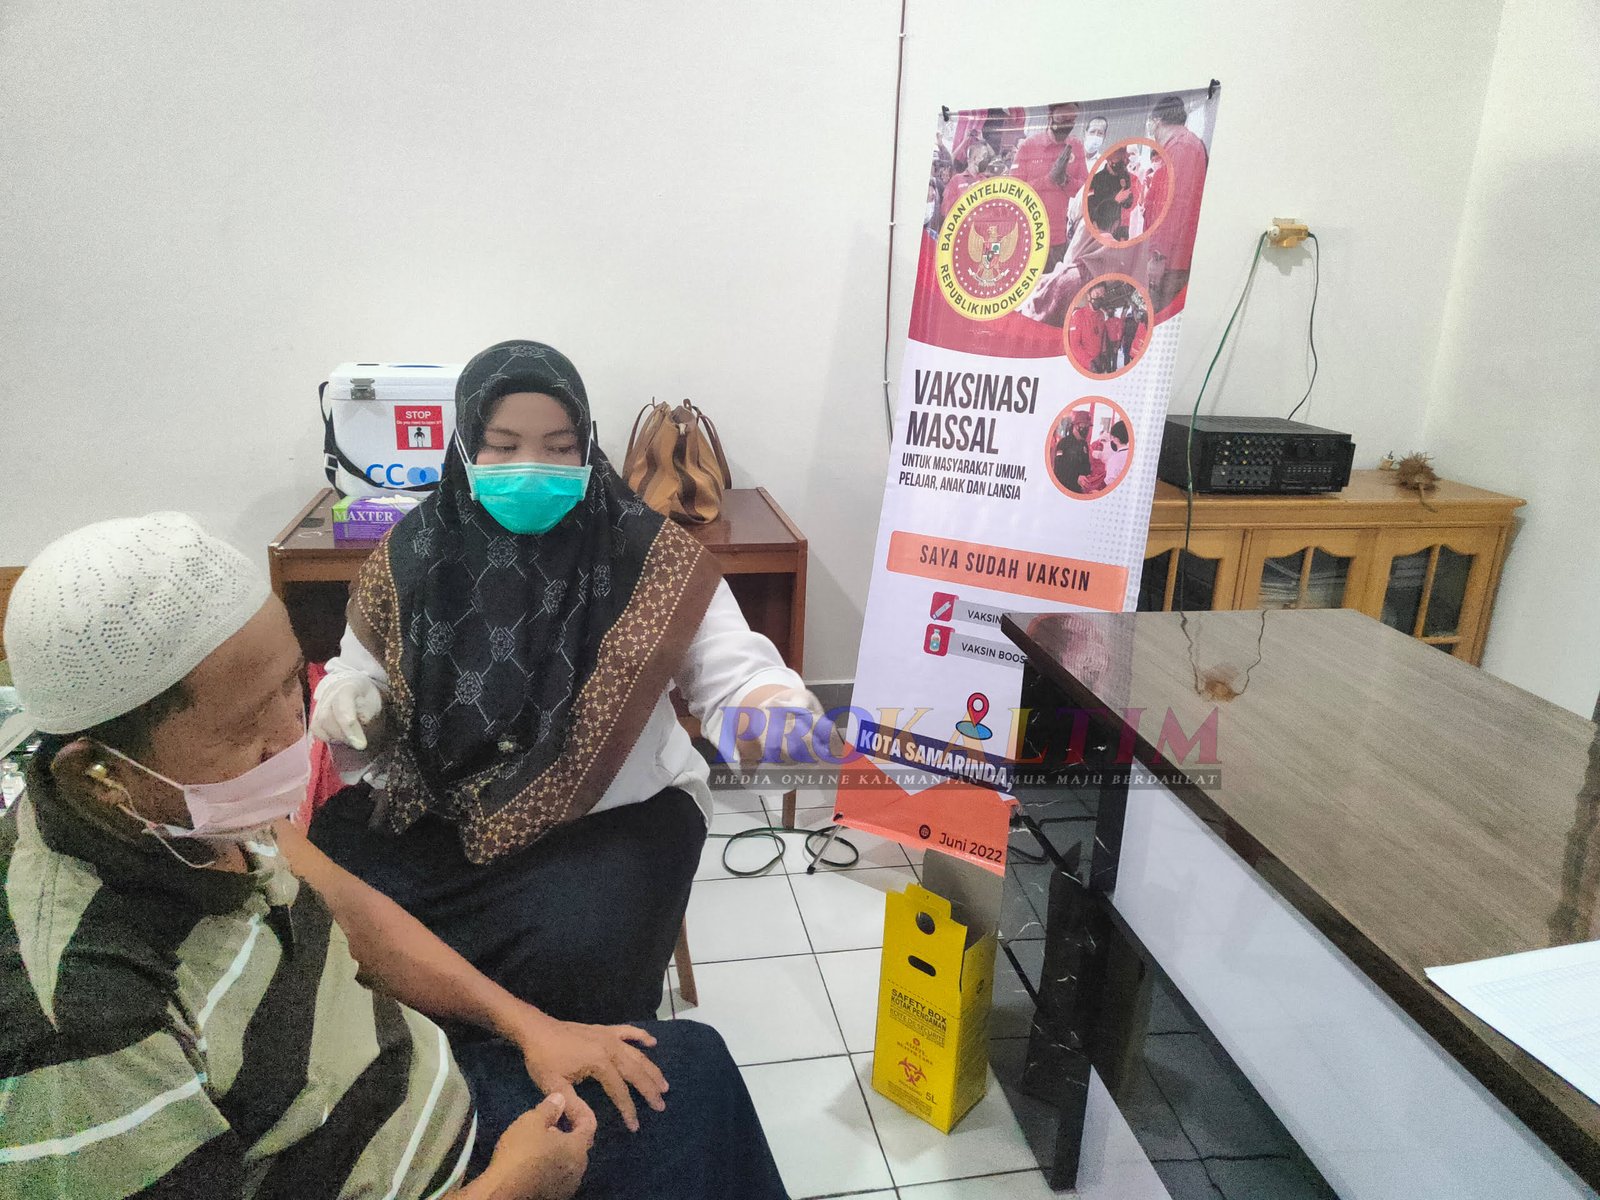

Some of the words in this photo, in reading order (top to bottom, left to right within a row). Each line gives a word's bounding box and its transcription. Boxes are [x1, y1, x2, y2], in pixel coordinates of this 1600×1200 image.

[941, 204, 967, 251] BADAN
[966, 182, 1024, 206] INTELIJEN
[1022, 194, 1045, 252] NEGARA
[940, 264, 979, 315] REPUBLIK
[979, 267, 1039, 315] INDONESIA
[915, 369, 1039, 414] VAKSINASI
[405, 410, 432, 419] STOP
[906, 410, 999, 454] MASSAL
[901, 452, 931, 470] UNTUK
[932, 456, 994, 477] MASYARAKAT
[995, 463, 1027, 482] UMUM,
[899, 471, 938, 491] PELAJAR,
[939, 476, 964, 493] ANAK
[966, 480, 986, 496] DAN
[987, 483, 1021, 500] LANSIA
[335, 510, 394, 522] MAXTER
[920, 544, 958, 569] SAYA
[965, 552, 1019, 579] SUDAH
[1026, 562, 1091, 591] VAKSIN
[968, 609, 1001, 624] VAKSIN
[961, 642, 996, 658] VAKSIN
[998, 650, 1029, 664] BOOS
[860, 729, 901, 757] KOTA
[904, 742, 1013, 793] SAMARINDA,
[939, 832, 967, 852] Juni
[969, 842, 1003, 863] 2022
[891, 988, 926, 1011] SAFETY
[928, 1008, 947, 1025] BOX
[891, 995, 911, 1012] KOTAK
[913, 1007, 947, 1032] PENGAMAN
[926, 1091, 937, 1105] 5L
